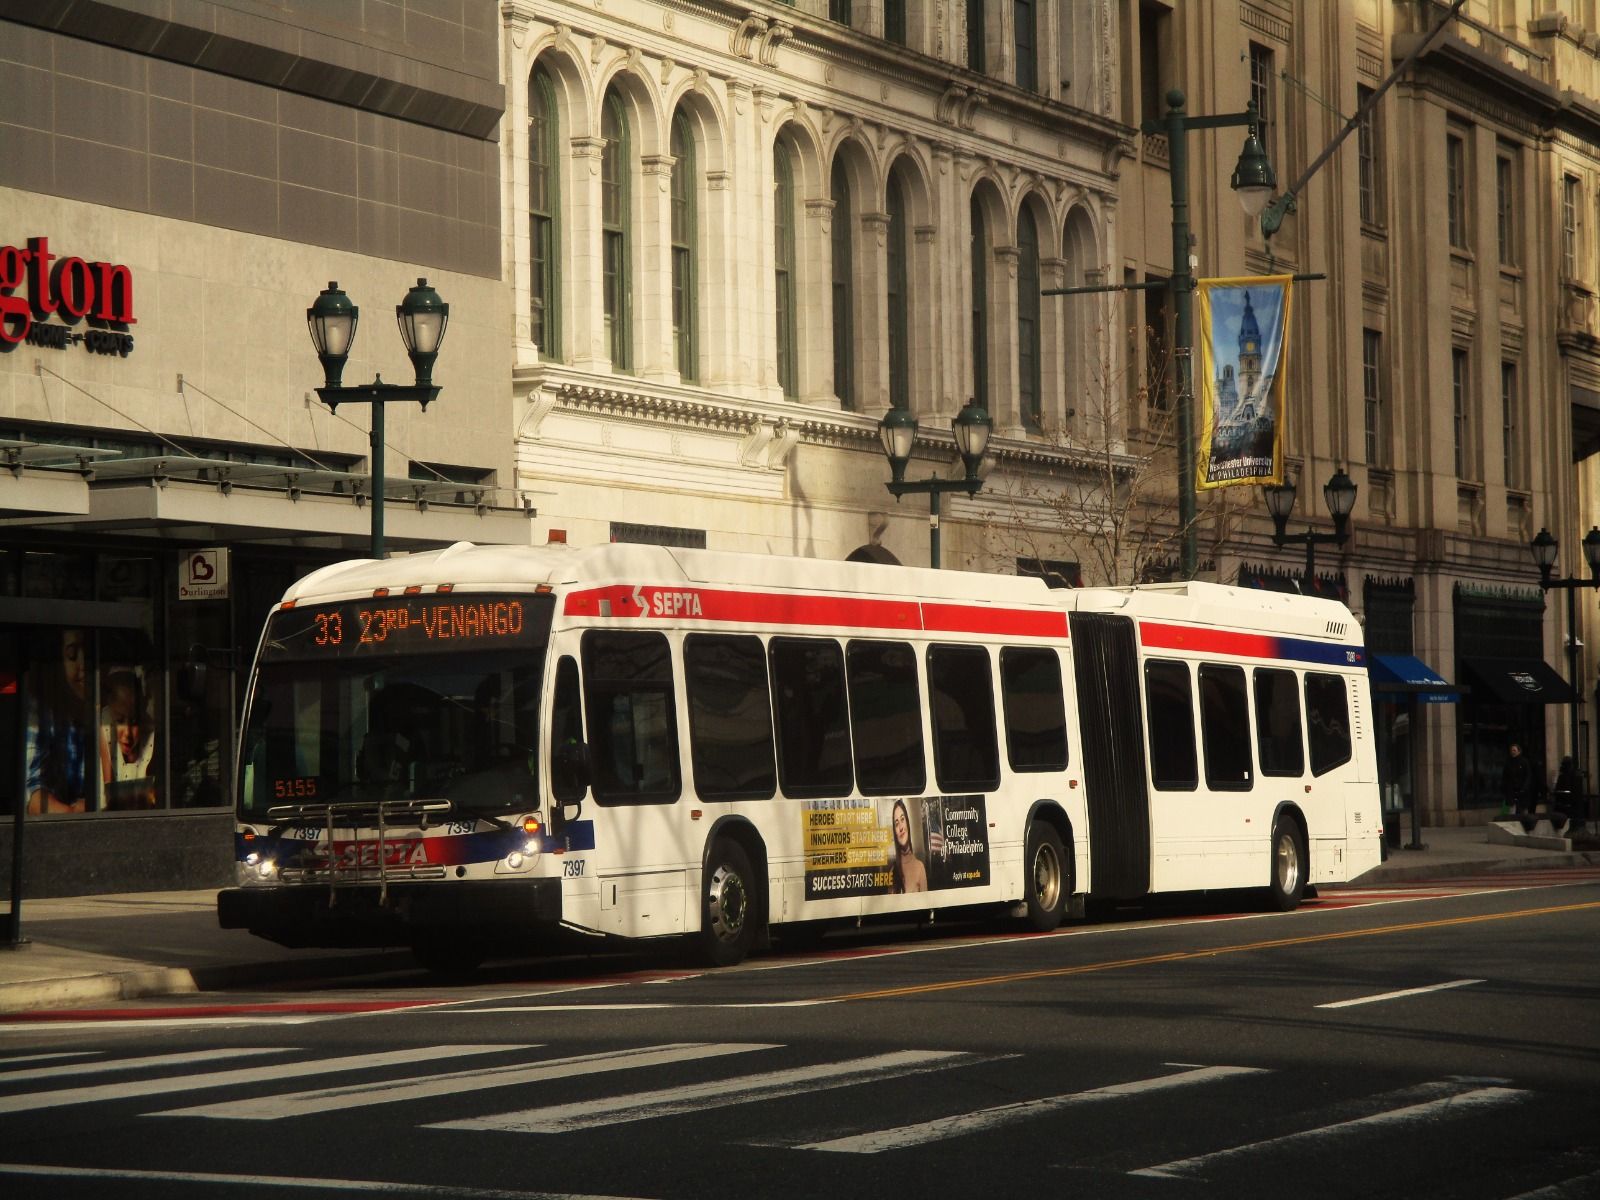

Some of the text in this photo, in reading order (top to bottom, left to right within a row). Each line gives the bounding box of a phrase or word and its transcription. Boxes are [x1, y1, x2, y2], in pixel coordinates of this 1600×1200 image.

[1242, 456, 1273, 467] University
[1217, 467, 1272, 480] PHILADELPHIA
[180, 586, 226, 599] Burlington
[652, 591, 703, 616] SEPTA
[314, 611, 343, 645] 33
[274, 778, 317, 798] 5155
[809, 811, 873, 826] HEROES START HERE
[944, 806, 979, 822] Community
[292, 826, 322, 840] 7397
[446, 820, 478, 836] 7397
[946, 824, 968, 840] College
[810, 830, 888, 846] INNOVATORS START HERE
[343, 842, 428, 866] SEPTA
[847, 850, 867, 863] START
[867, 849, 885, 862] HERE
[940, 838, 984, 863] of Philadelphia
[562, 859, 586, 877] 7397
[812, 871, 894, 892] SUCCESS STARTS HERE
